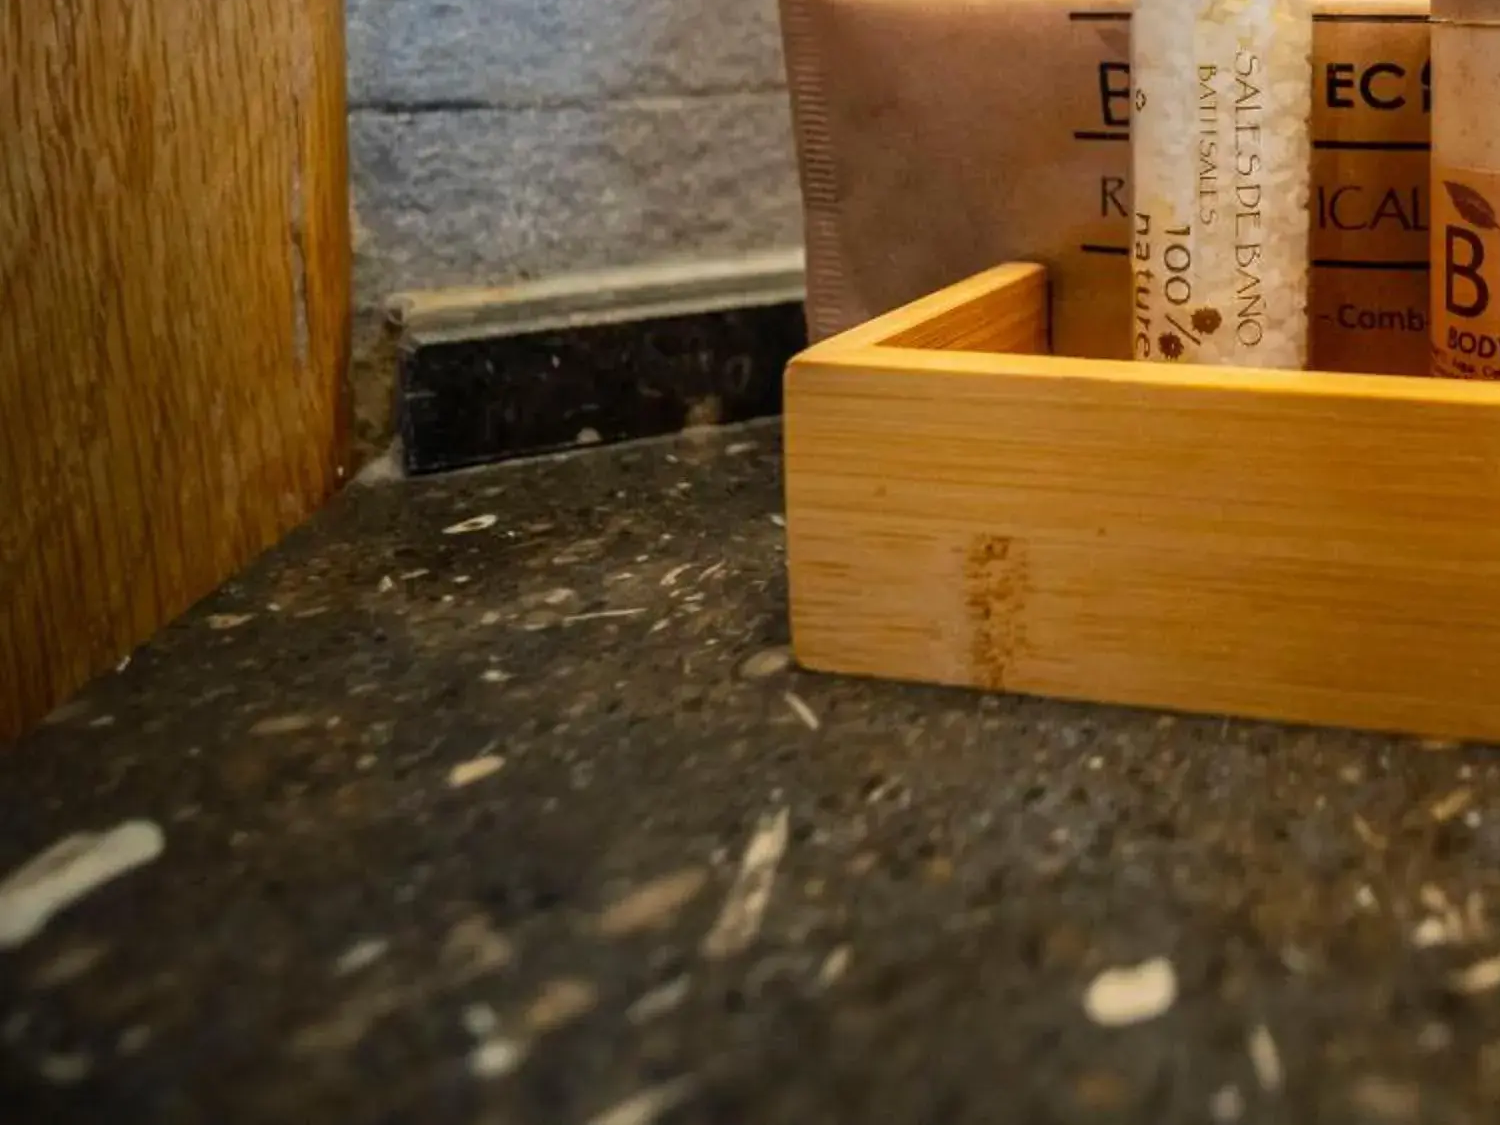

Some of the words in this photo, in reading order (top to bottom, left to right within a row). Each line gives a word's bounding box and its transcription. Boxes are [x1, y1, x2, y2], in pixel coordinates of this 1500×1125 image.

[1235, 53, 1263, 176] SALES
[1235, 184, 1262, 237] DE
[1235, 243, 1267, 348] BAÑO
